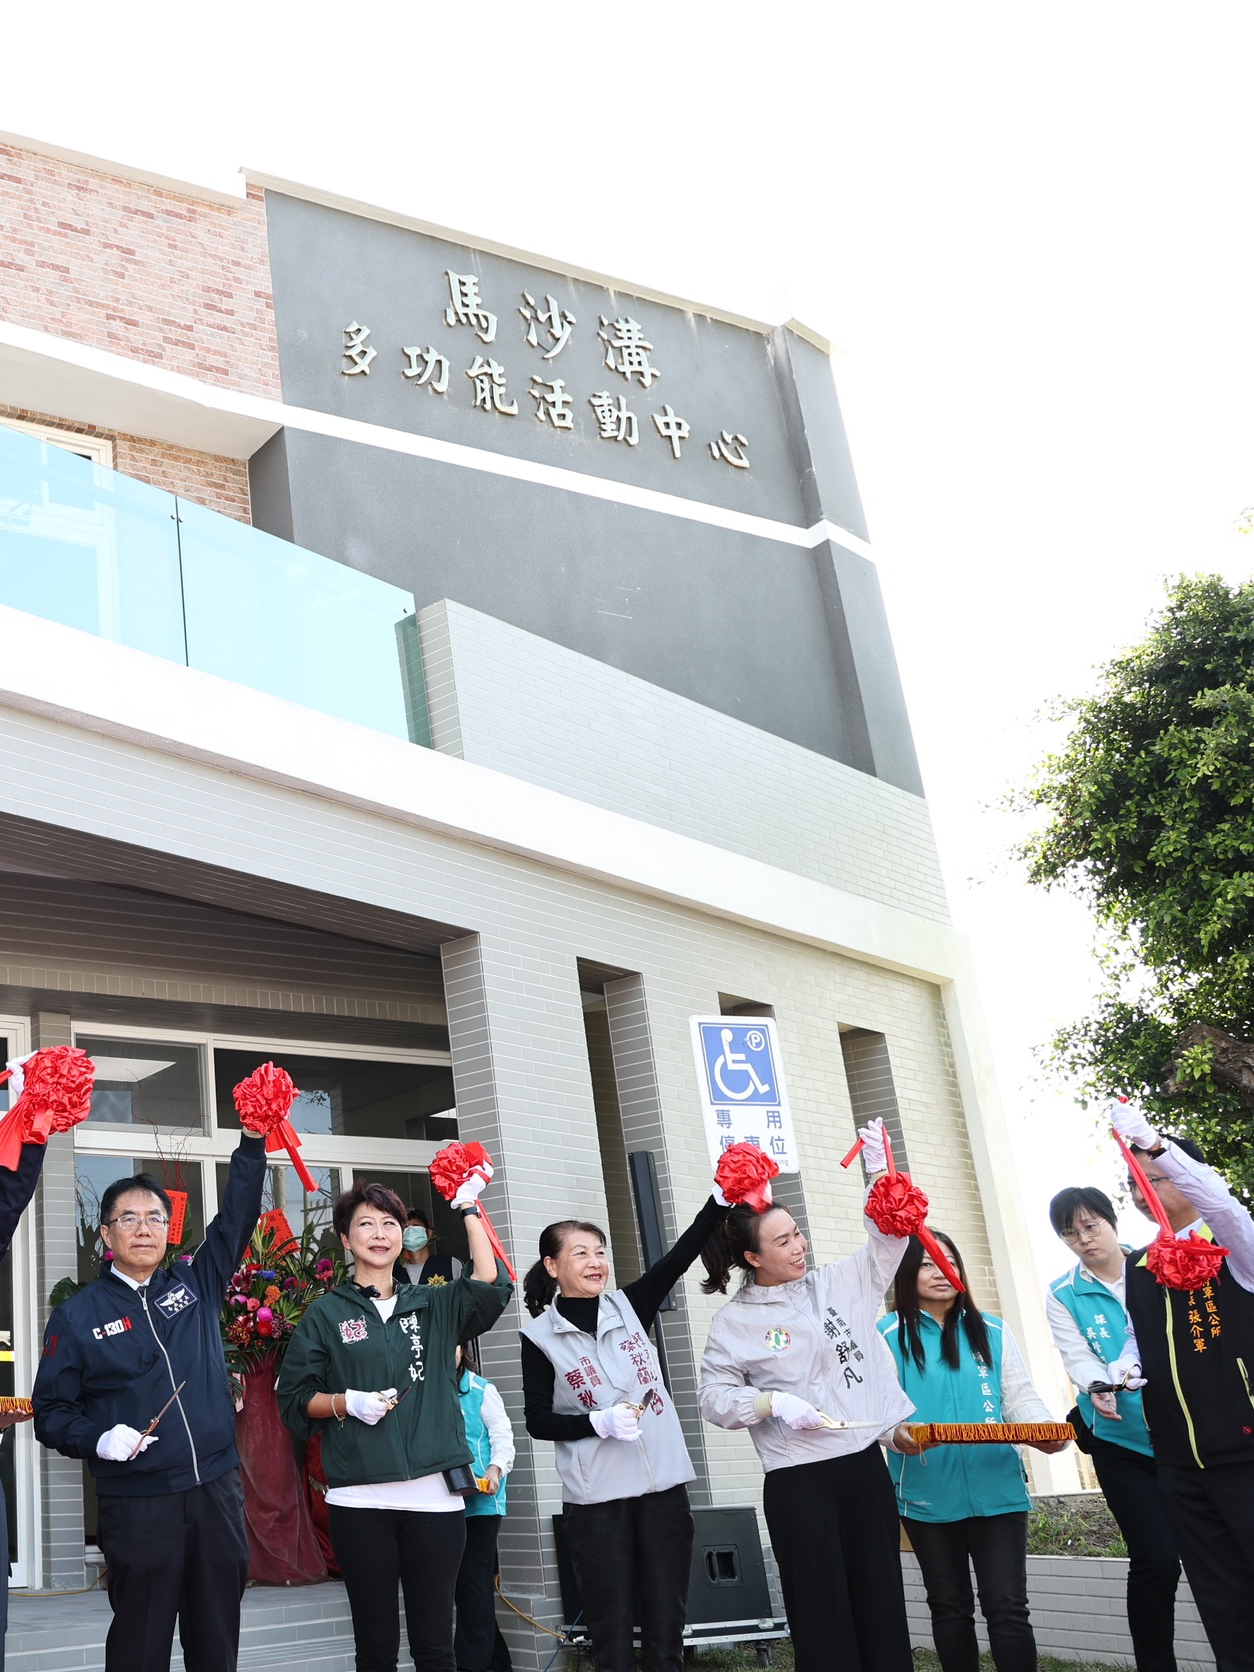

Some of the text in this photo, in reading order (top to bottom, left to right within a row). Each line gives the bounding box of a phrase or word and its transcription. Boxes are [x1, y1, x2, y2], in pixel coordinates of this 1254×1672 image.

[445, 269, 661, 388] 馬沙溝
[342, 320, 750, 468] 多功能活動中心
[715, 1109, 782, 1129] 專用
[92, 1316, 133, 1340] C-130H
[398, 1311, 426, 1382] 陳亭妃
[1188, 1308, 1208, 1354] 張介軍
[564, 1368, 600, 1410] 蔡秋
[578, 1355, 603, 1388] 市議員
